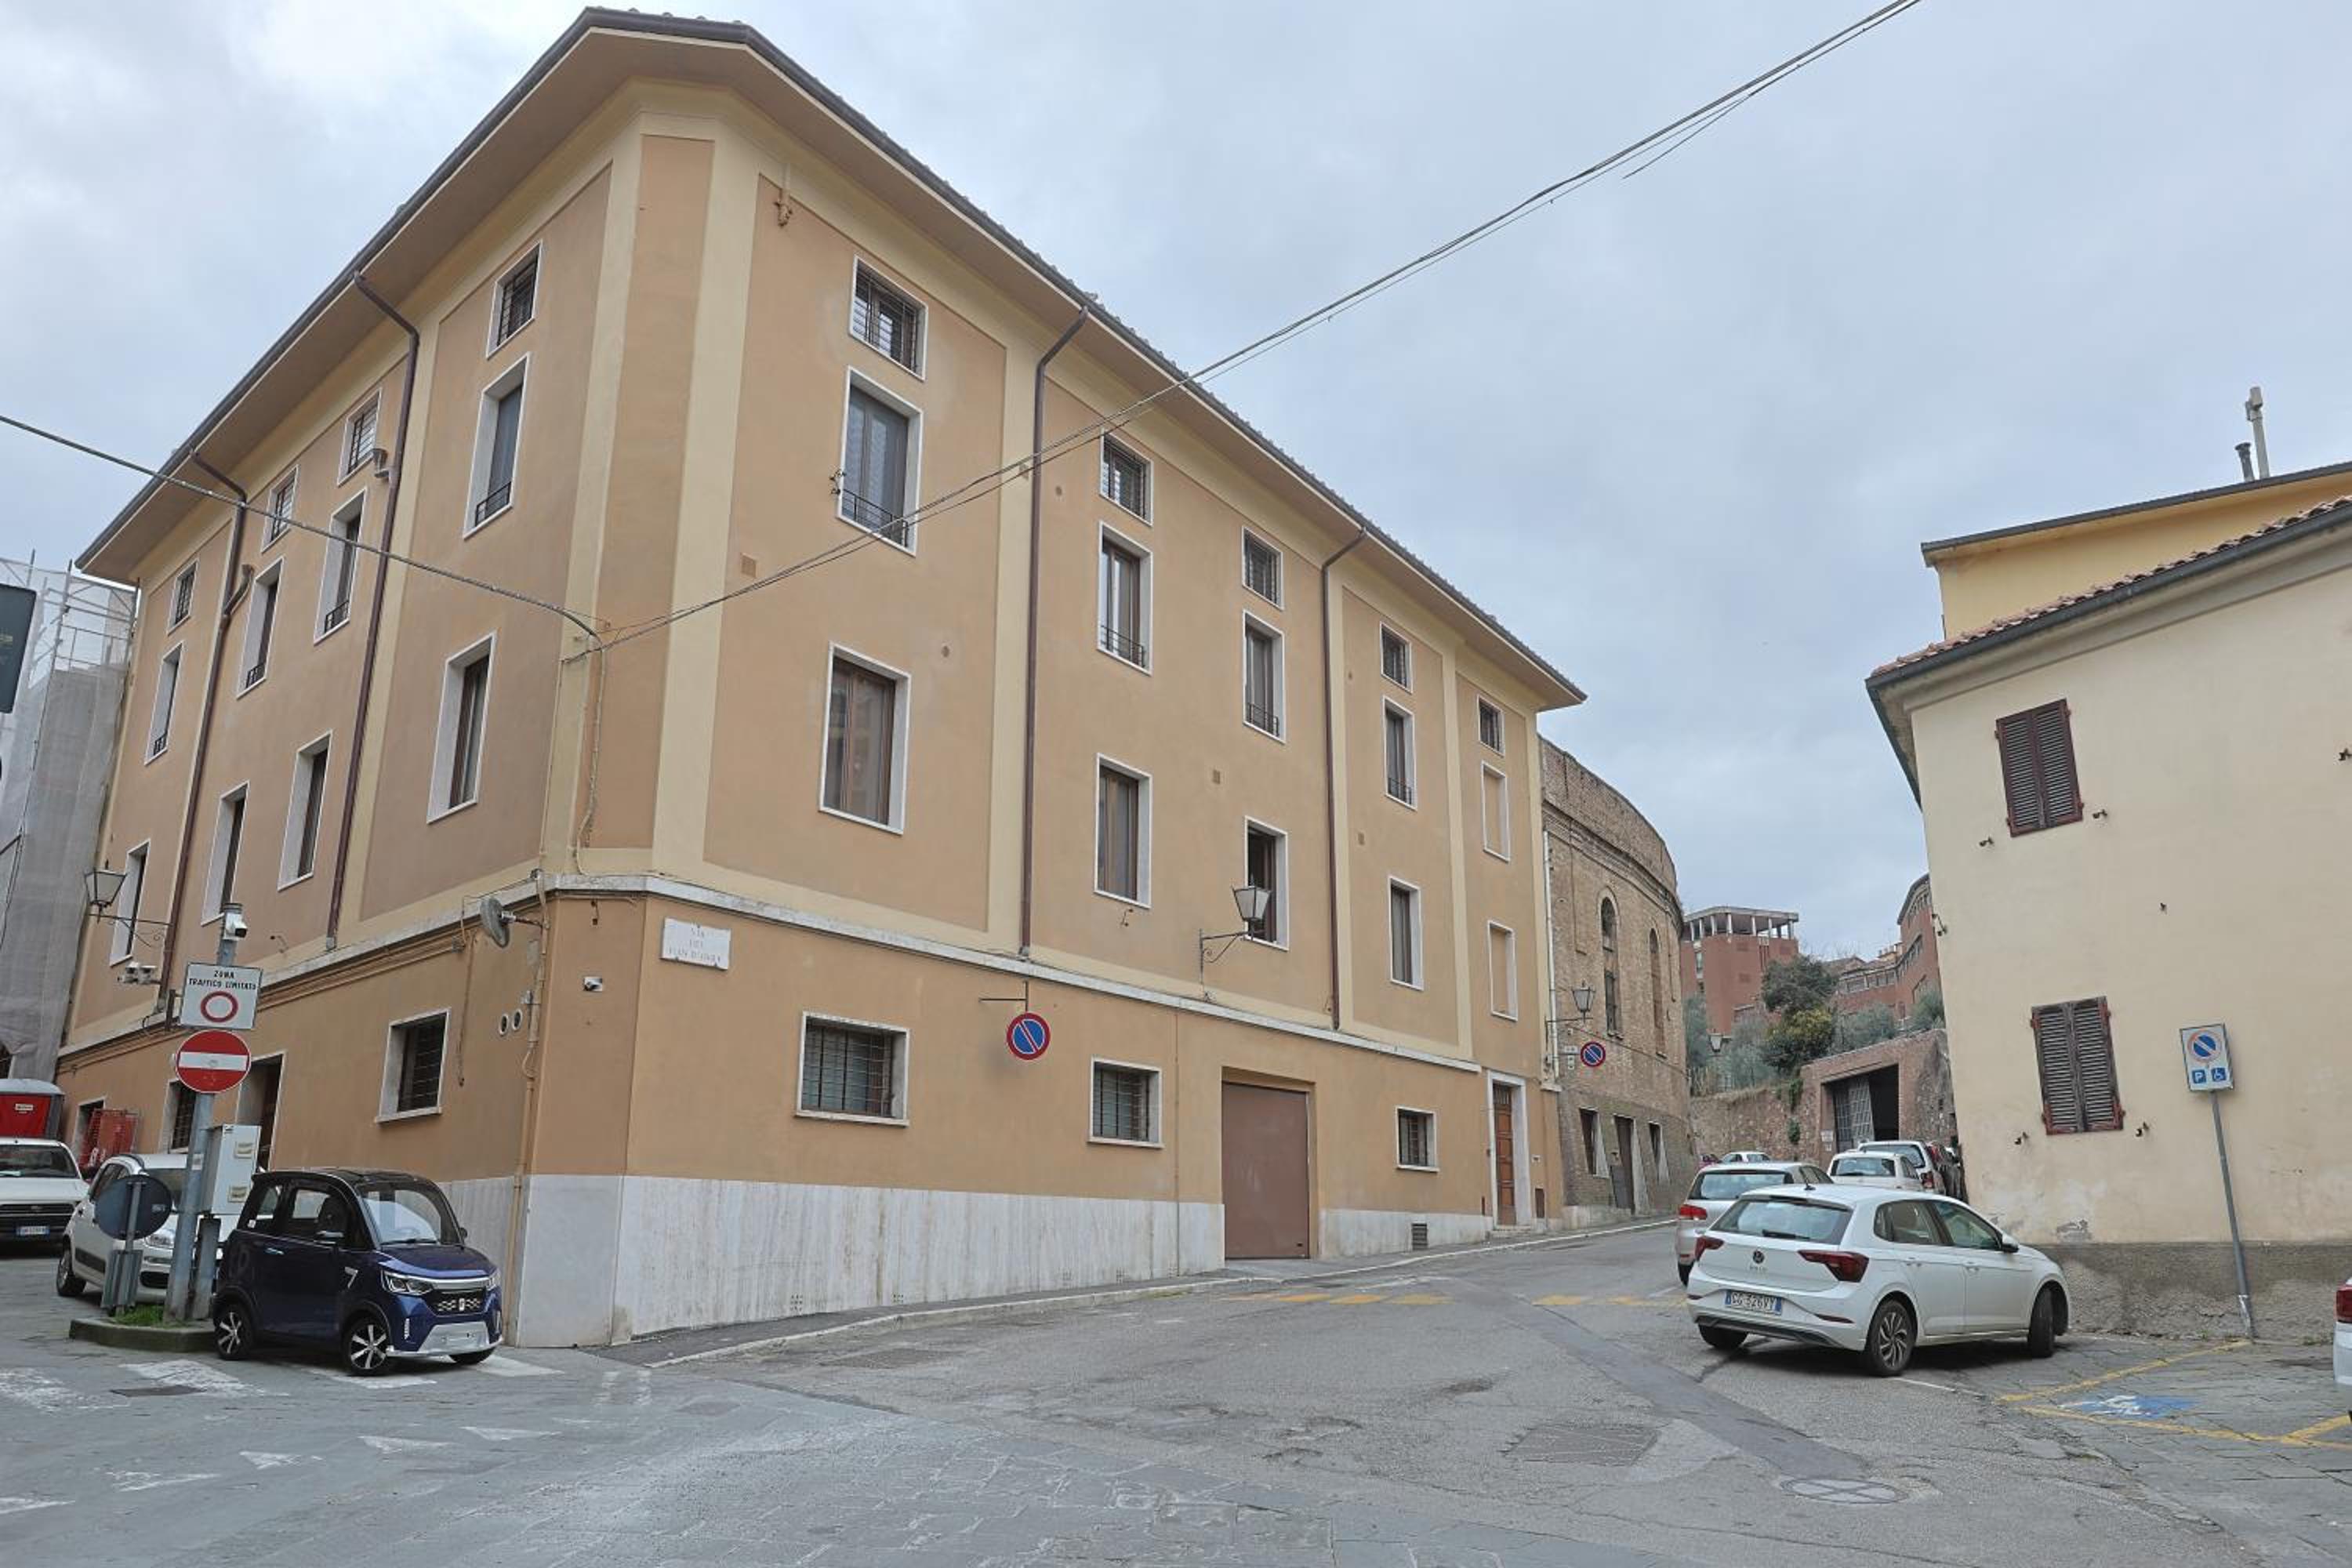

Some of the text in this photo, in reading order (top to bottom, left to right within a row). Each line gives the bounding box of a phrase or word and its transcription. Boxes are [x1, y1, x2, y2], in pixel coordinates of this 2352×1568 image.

[214, 970, 234, 979] ZONA
[189, 978, 256, 990] TRAFFICO LIMITATO
[2194, 1072, 2204, 1083] P
